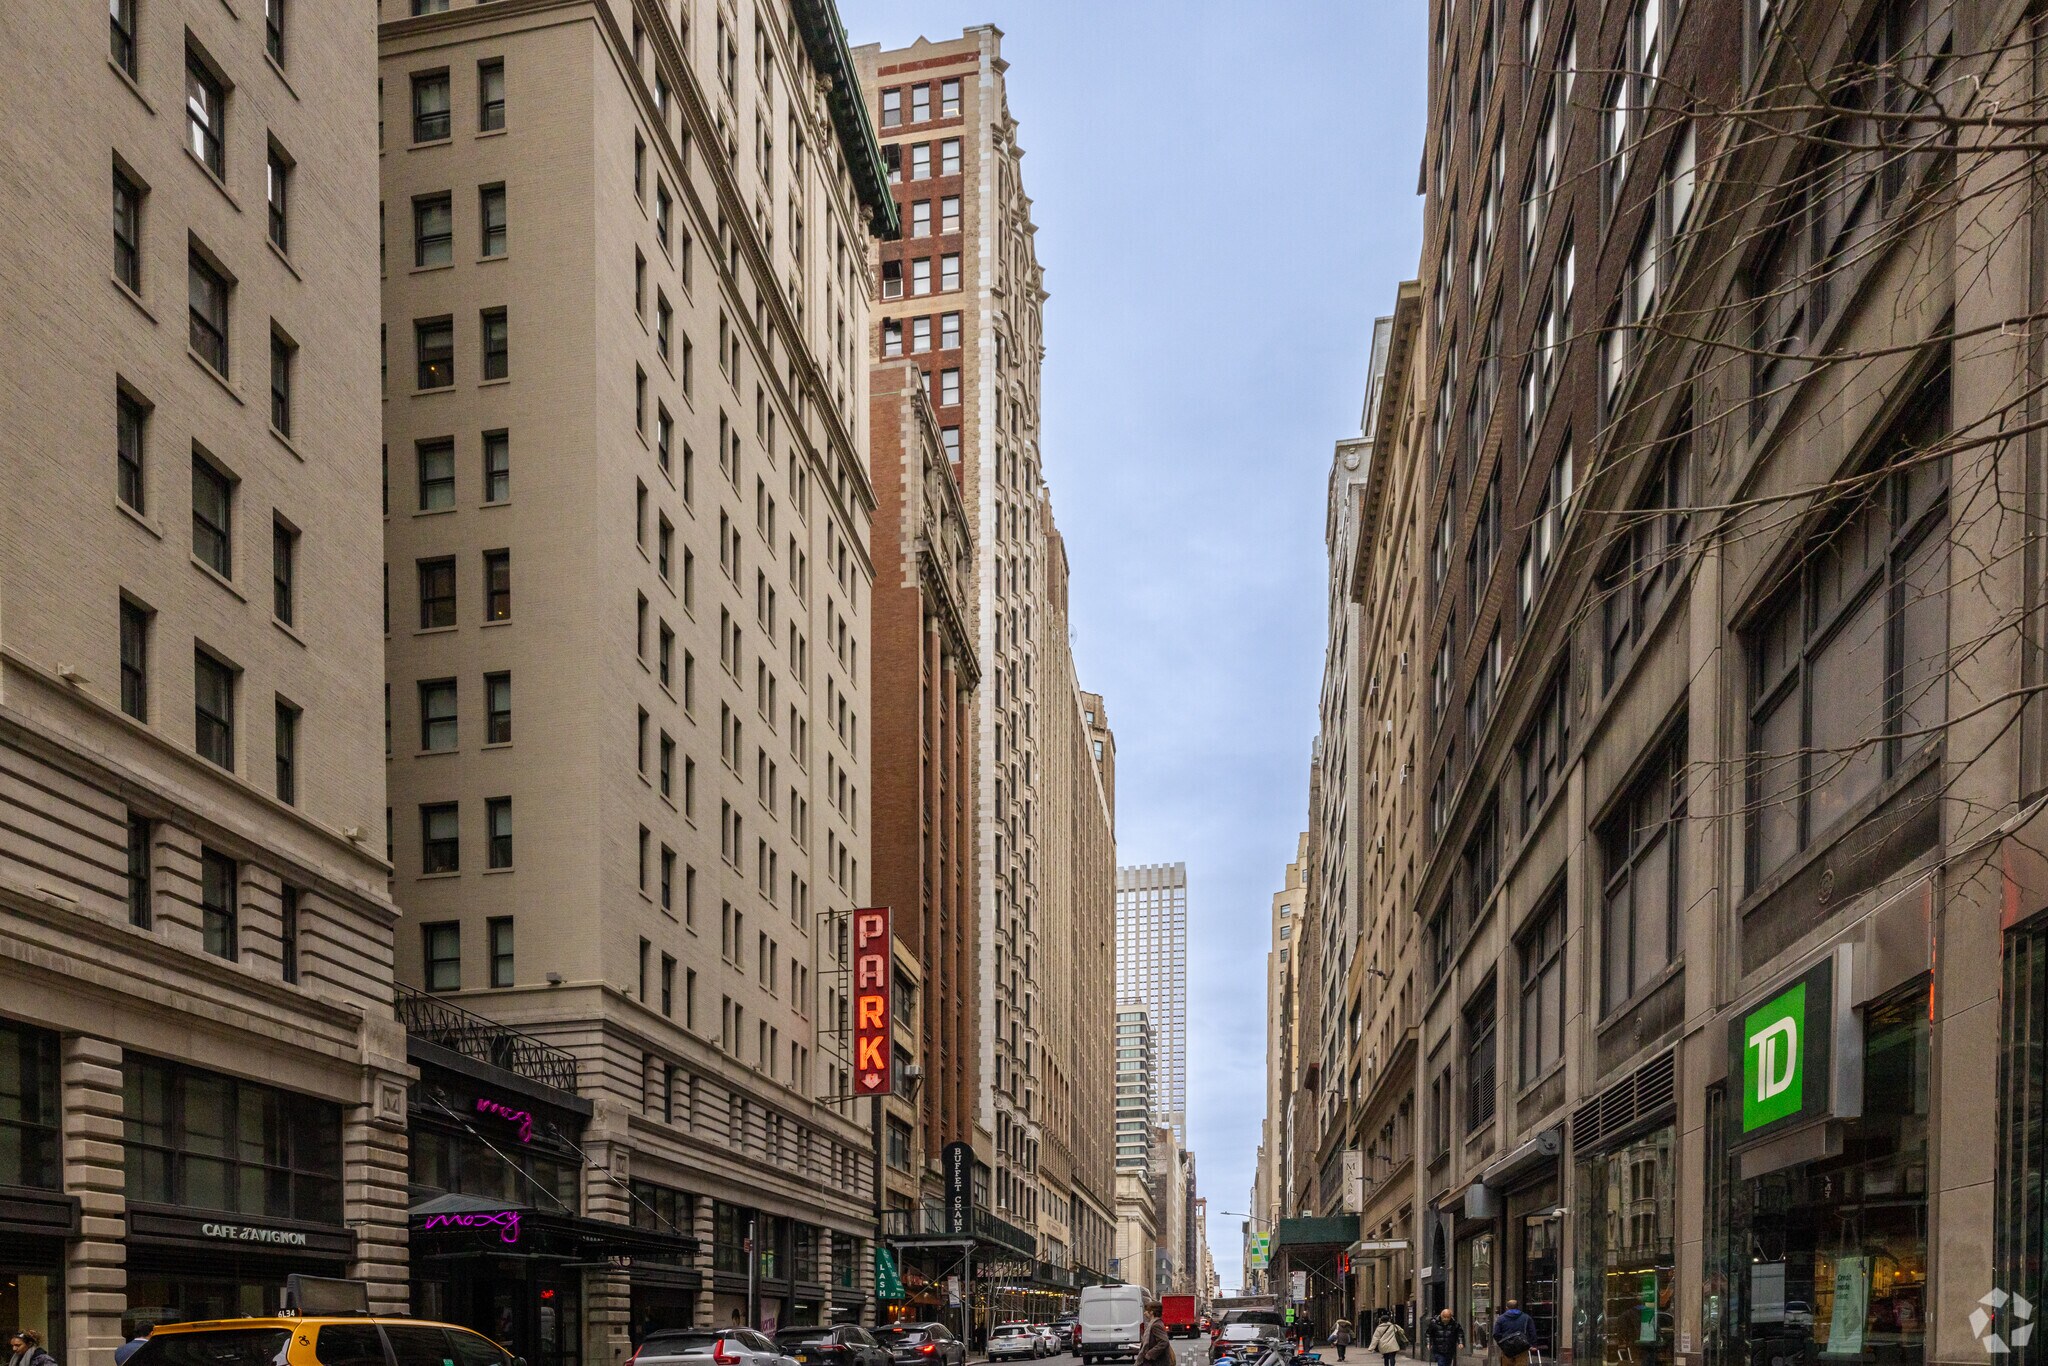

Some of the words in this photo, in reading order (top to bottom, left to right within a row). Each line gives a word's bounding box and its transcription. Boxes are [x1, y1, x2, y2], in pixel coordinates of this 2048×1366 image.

[859, 914, 884, 1071] PARK
[1749, 1016, 1797, 1103] TD
[954, 1147, 962, 1192] BUFFET
[1346, 1162, 1356, 1208] MACARON
[202, 1223, 238, 1239] CAFE
[425, 1211, 523, 1243] moxy
[277, 1310, 295, 1318] 6L34
